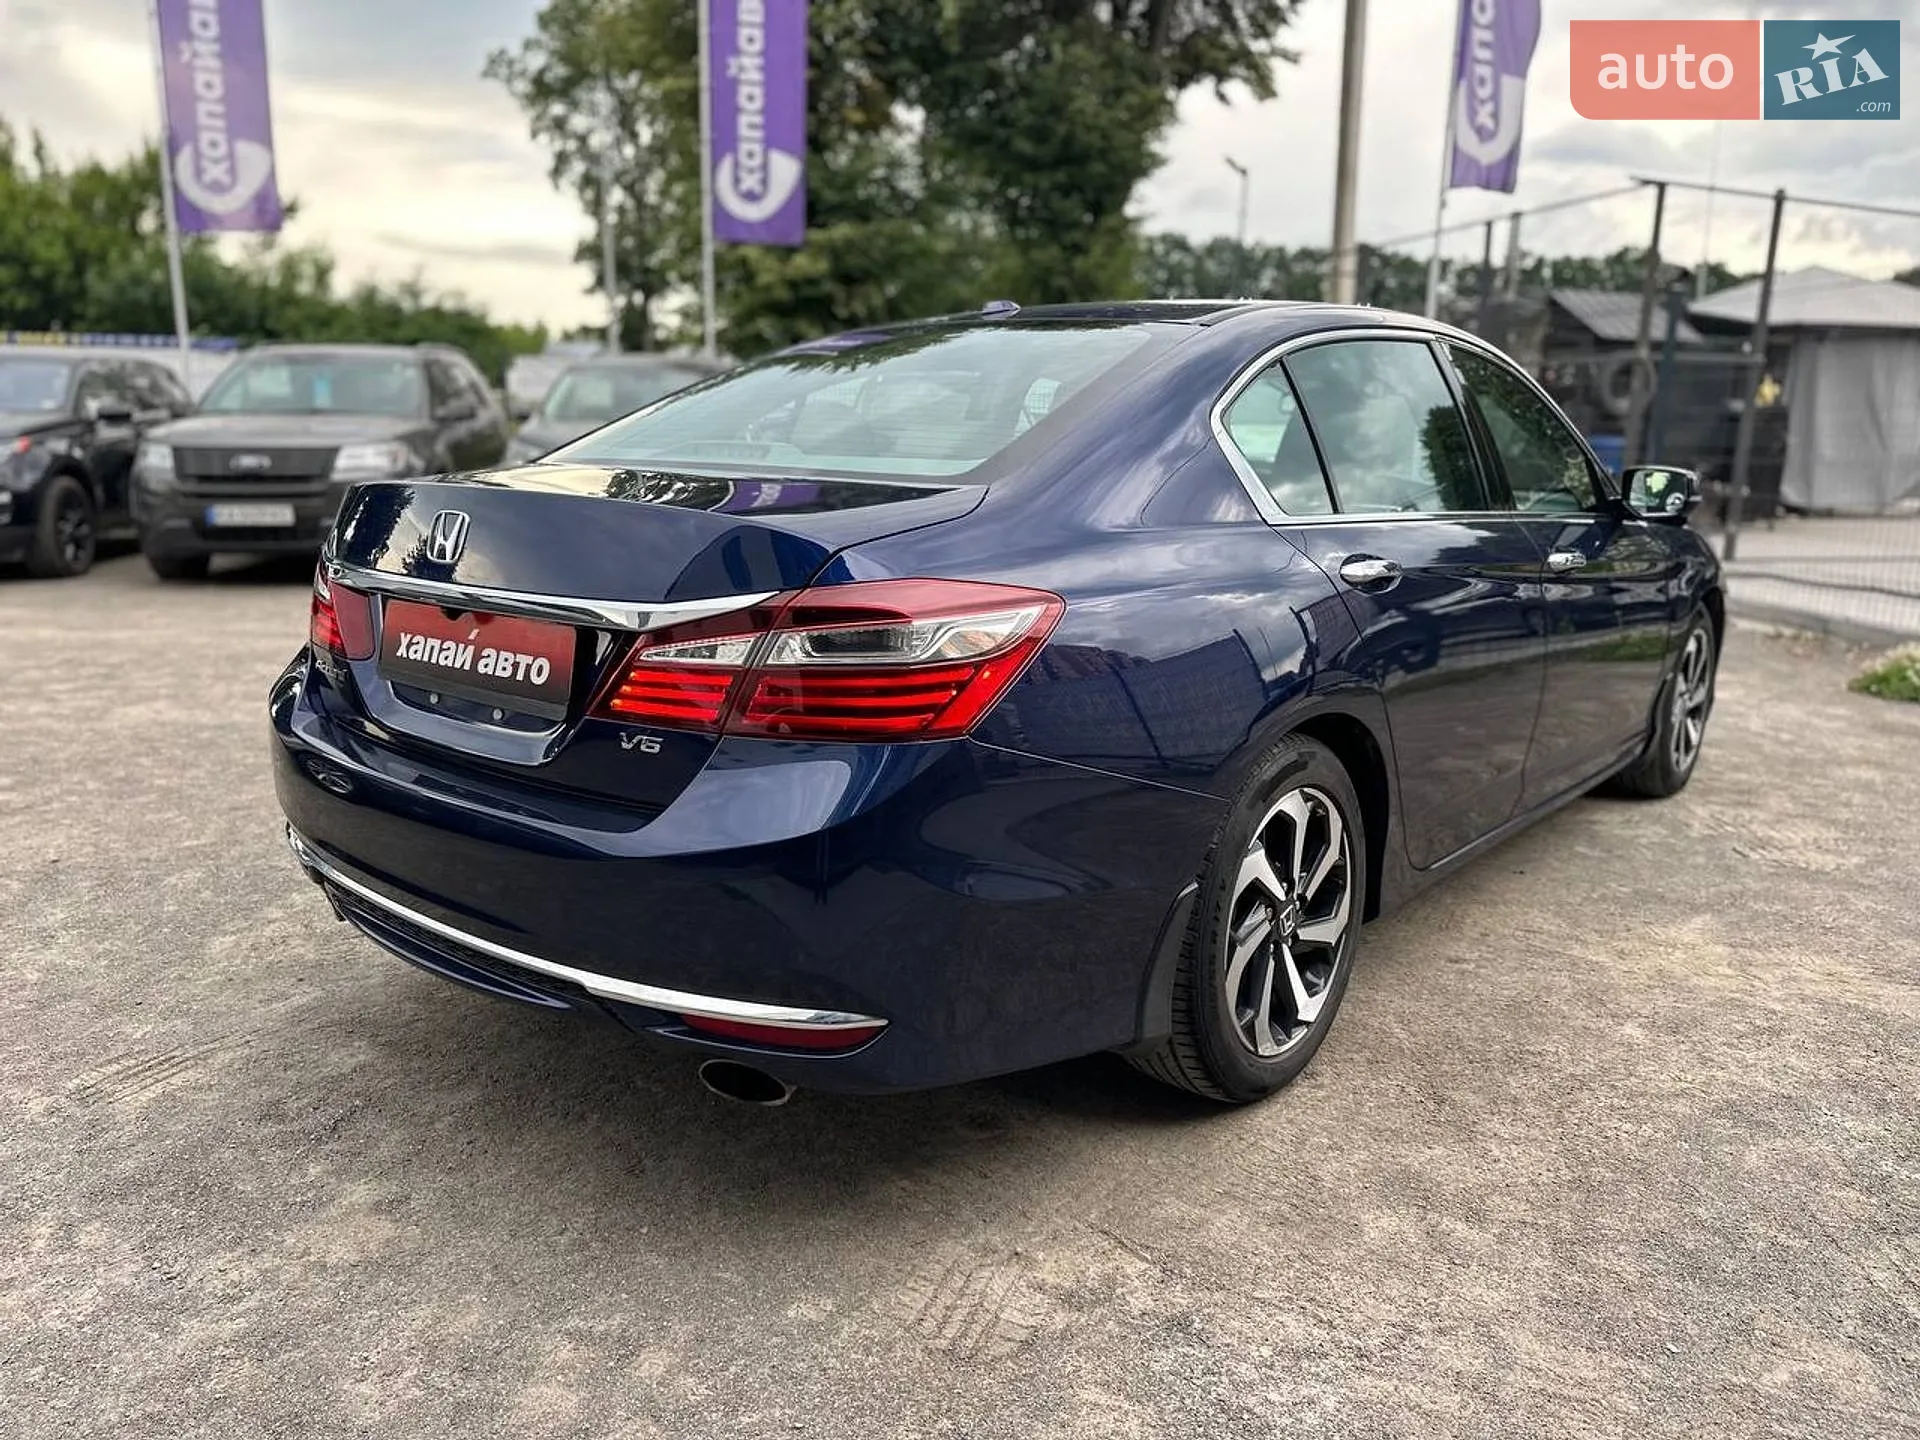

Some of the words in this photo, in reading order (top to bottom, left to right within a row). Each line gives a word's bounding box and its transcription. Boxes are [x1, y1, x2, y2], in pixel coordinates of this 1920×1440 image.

[179, 0, 233, 187] хапайа
[476, 647, 551, 686] авто
[619, 732, 664, 753] V6
